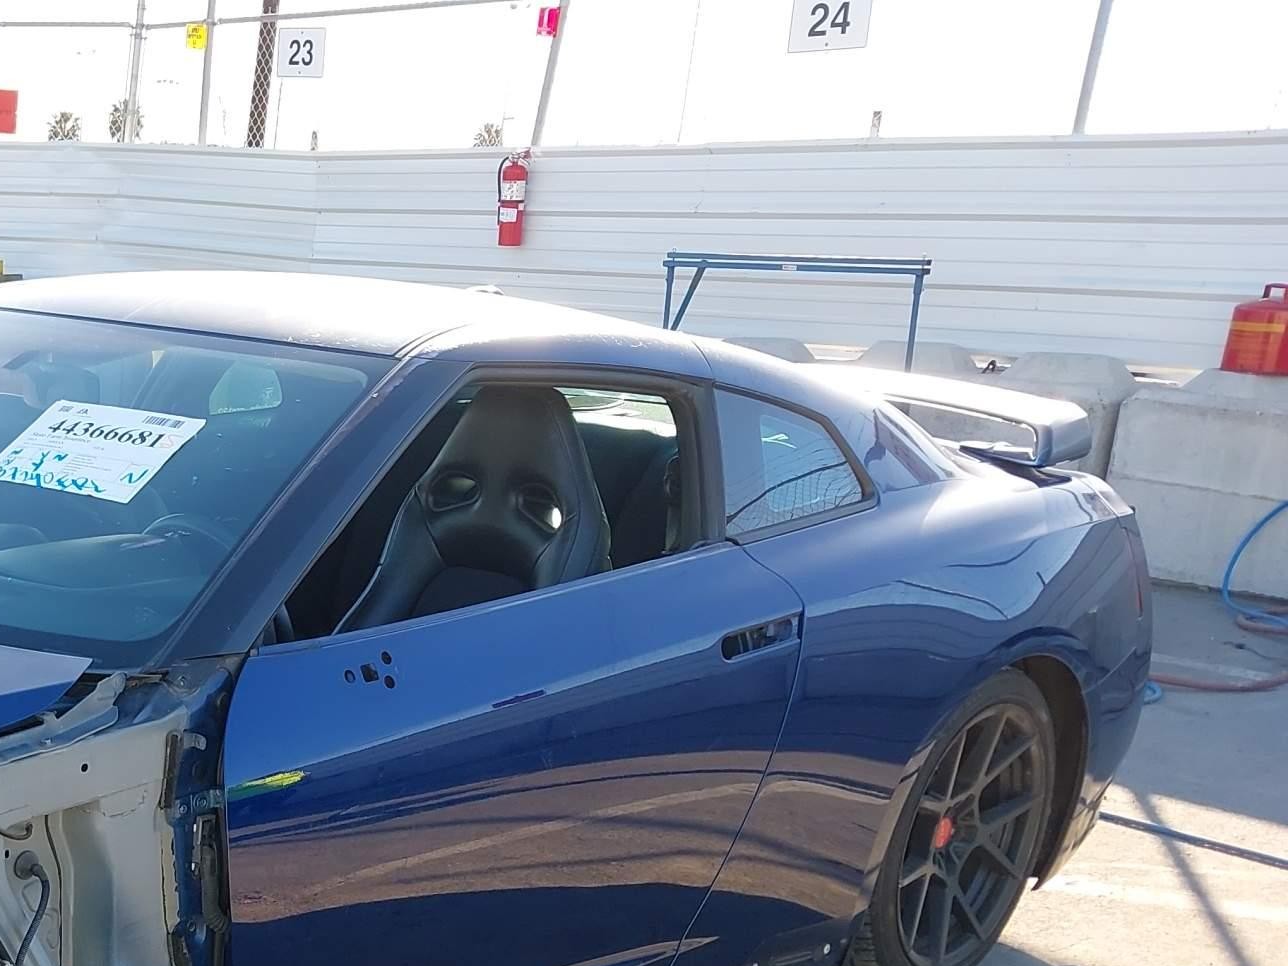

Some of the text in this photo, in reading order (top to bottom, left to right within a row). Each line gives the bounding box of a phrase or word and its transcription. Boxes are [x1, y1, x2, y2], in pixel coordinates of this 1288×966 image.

[808, 1, 851, 37] 24
[288, 39, 314, 66] 23
[48, 419, 166, 448] 44366681
